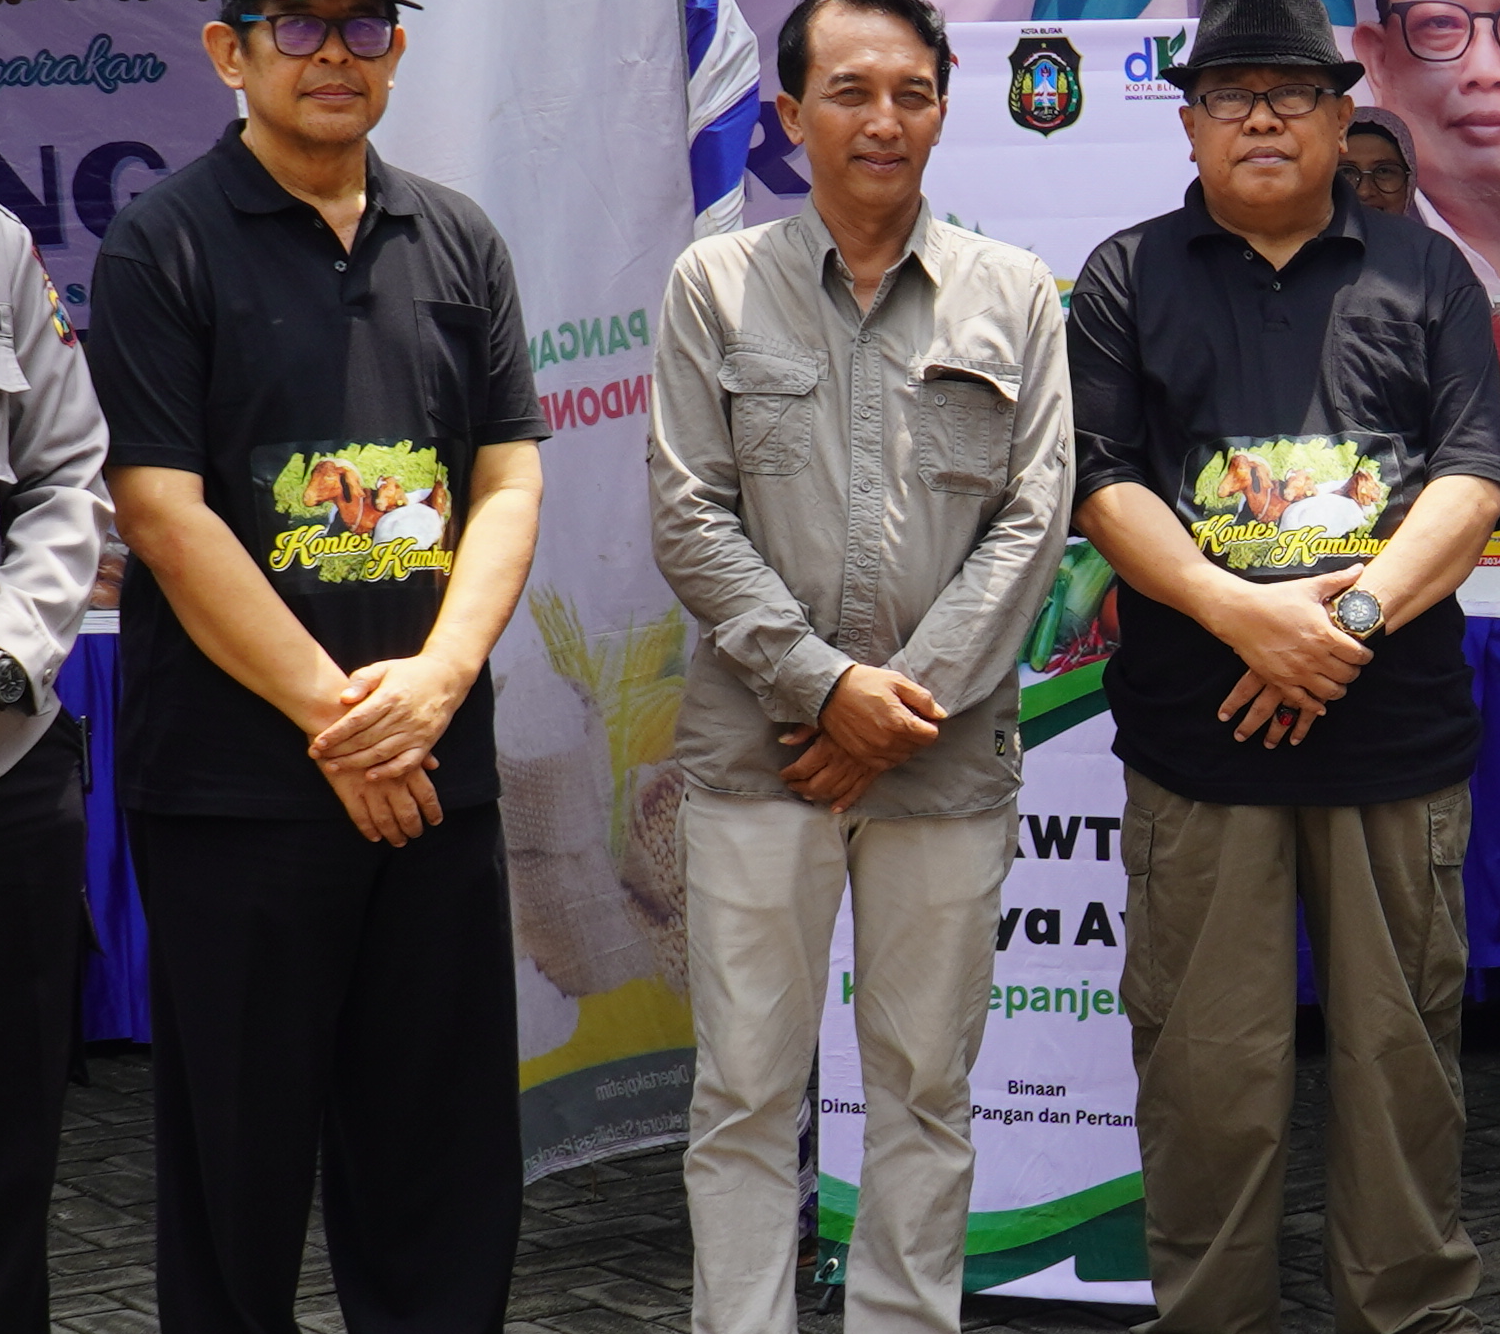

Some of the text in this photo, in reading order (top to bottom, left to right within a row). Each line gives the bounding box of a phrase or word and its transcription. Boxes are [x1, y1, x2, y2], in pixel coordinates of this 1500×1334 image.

[1020, 27, 1039, 35] KOTA
[1124, 25, 1187, 82] dK
[1125, 83, 1182, 92] KOTA BLIT
[268, 523, 374, 573] Kontes
[1191, 513, 1280, 555] Kontes
[989, 979, 1127, 1023] epanje
[1007, 1080, 1067, 1098] Binaan
[971, 1104, 1034, 1126] Pangan
[1038, 1108, 1071, 1125] dan
[1075, 1109, 1137, 1128] Pertan
